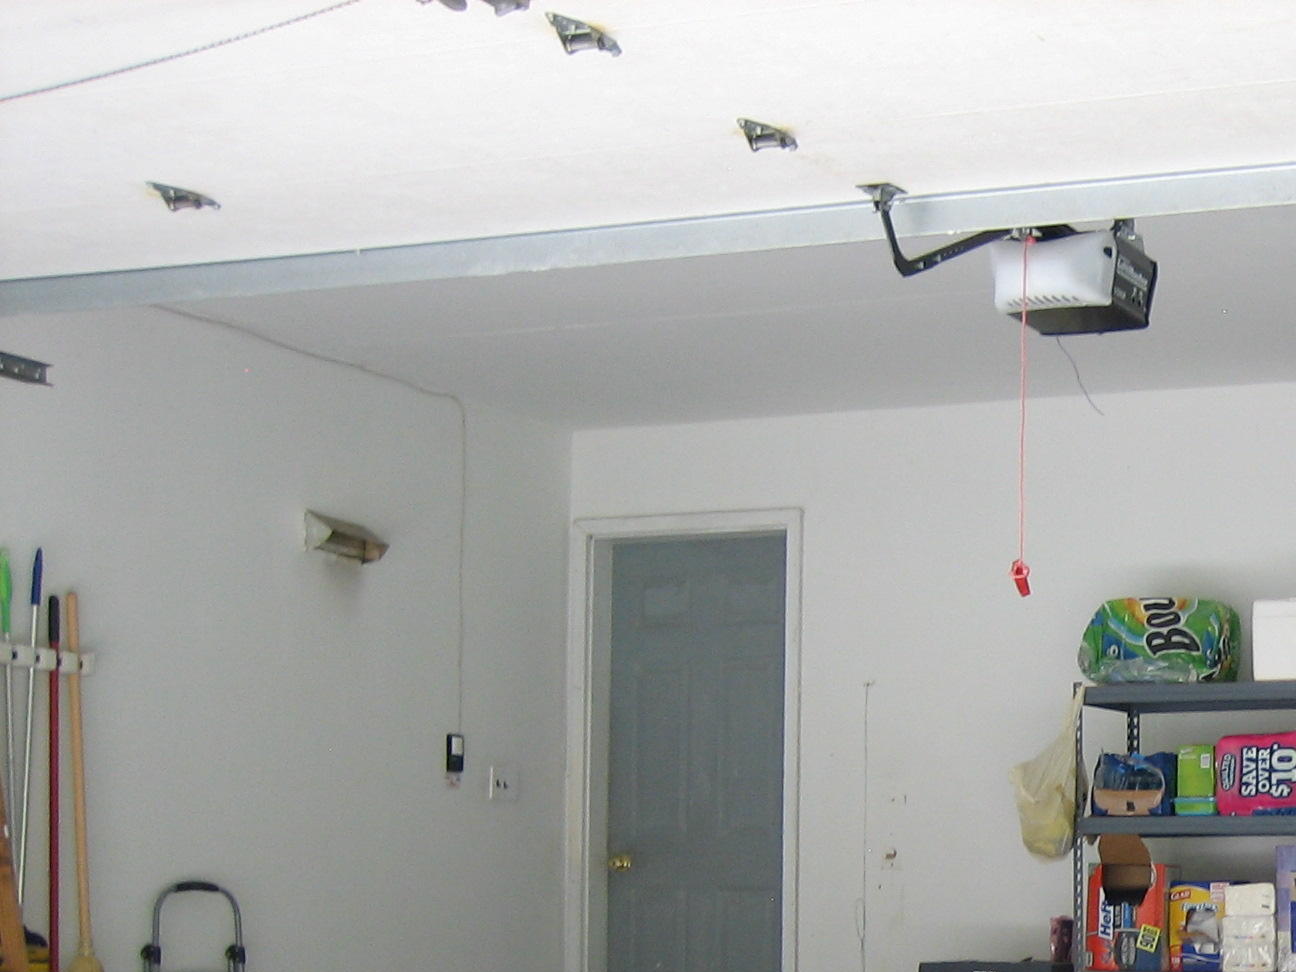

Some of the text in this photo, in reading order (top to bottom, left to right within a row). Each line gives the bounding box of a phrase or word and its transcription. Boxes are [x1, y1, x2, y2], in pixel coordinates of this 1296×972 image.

[1241, 747, 1257, 796] SAVE
[1258, 748, 1270, 793] OVER
[1099, 900, 1113, 936] Hef
